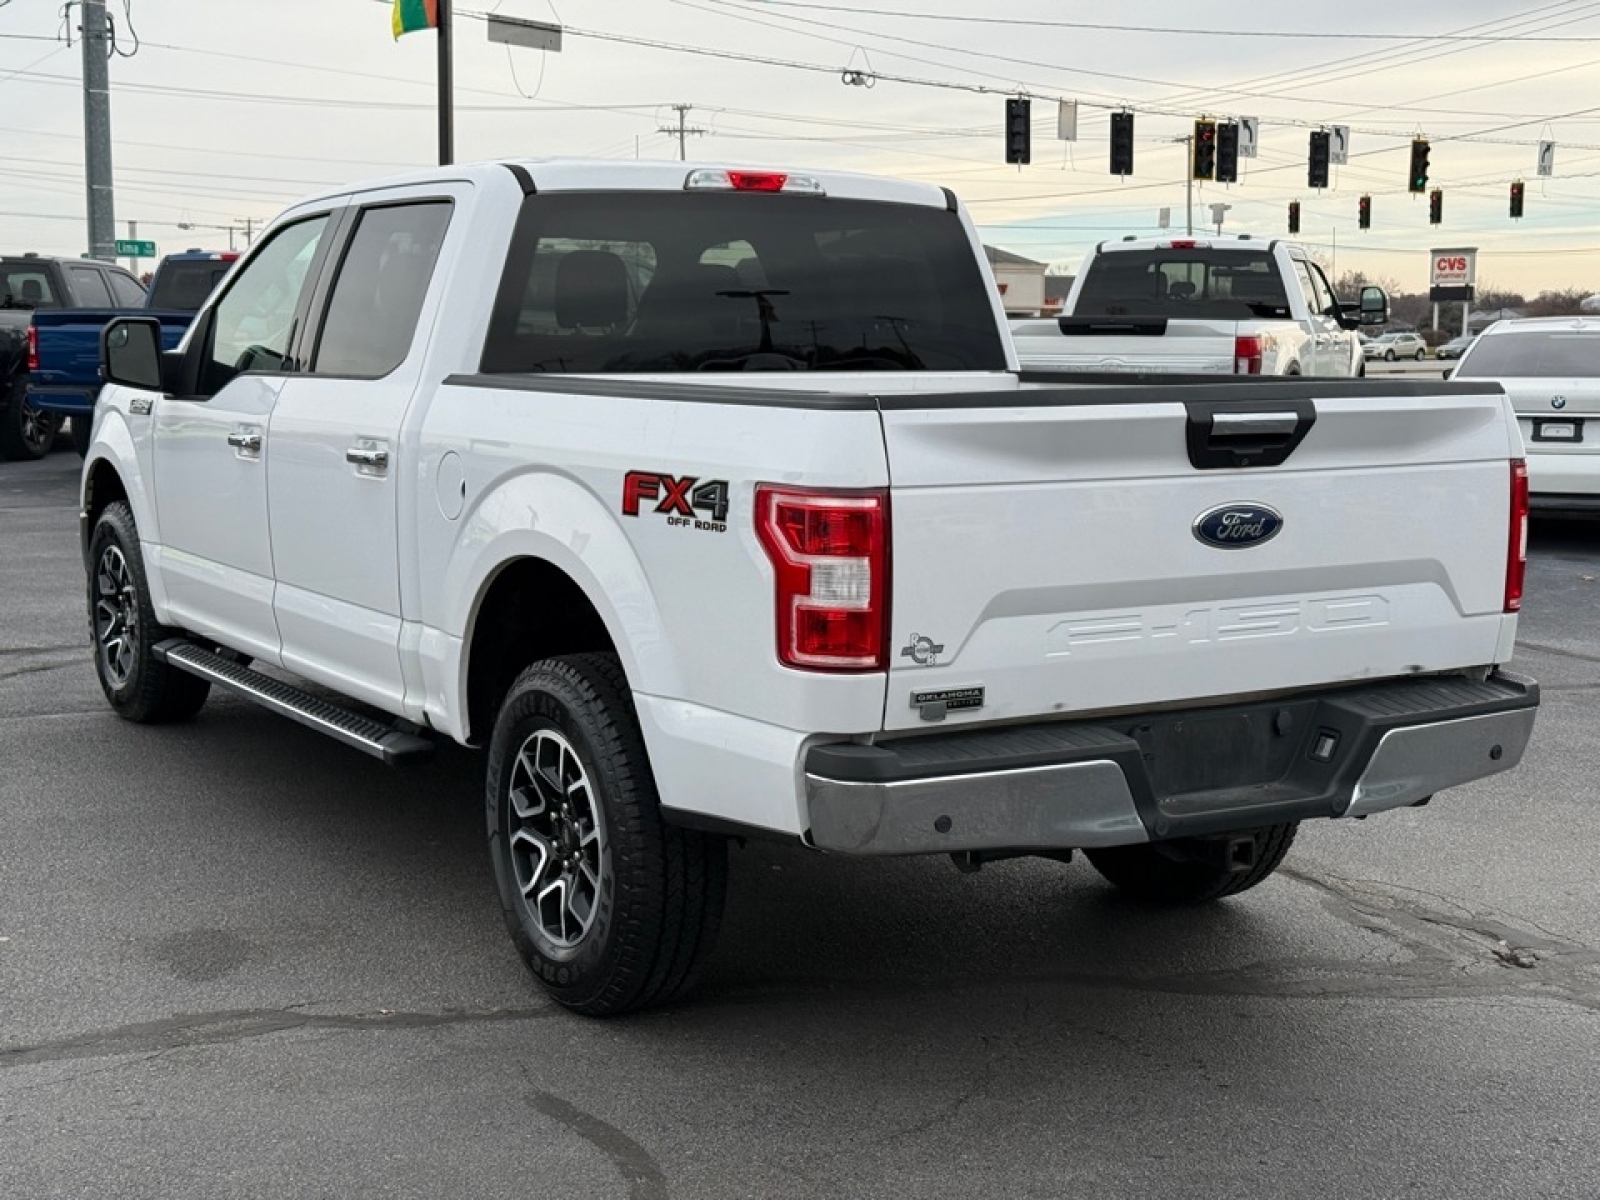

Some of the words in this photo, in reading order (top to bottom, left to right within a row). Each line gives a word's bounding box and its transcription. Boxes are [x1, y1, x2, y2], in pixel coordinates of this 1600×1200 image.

[117, 242, 139, 254] Lima
[1437, 257, 1467, 271] CVS
[1434, 272, 1467, 281] pharmacy
[622, 469, 730, 522] FX4
[667, 516, 691, 528] OFF
[694, 520, 728, 533] ROAD
[1216, 512, 1266, 539] Ford
[1045, 593, 1391, 657] F-150
[917, 689, 981, 701] OKLAHOMA
